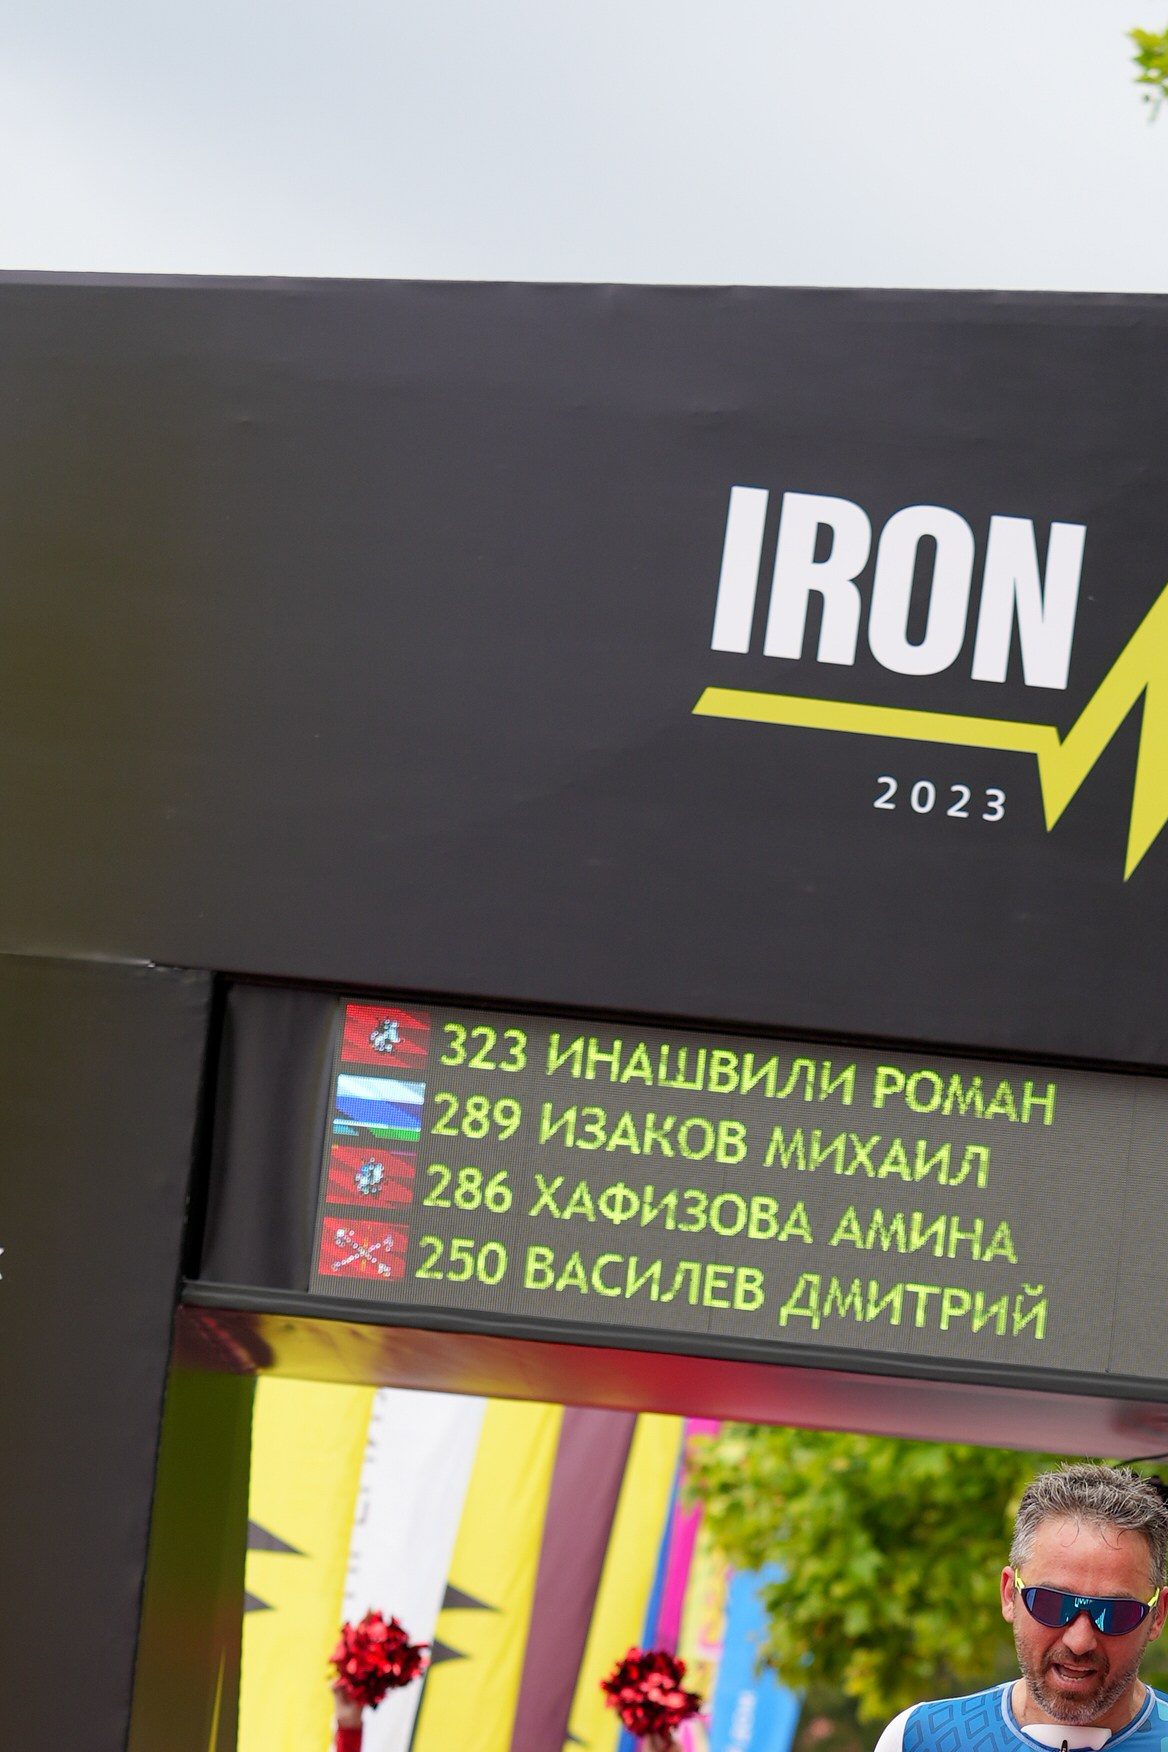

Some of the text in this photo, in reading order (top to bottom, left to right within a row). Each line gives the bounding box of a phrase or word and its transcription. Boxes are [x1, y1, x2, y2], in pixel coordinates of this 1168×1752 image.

[711, 486, 1086, 689] IRON
[873, 776, 1007, 822] 2023
[440, 1022, 1056, 1125] 323 ИНАШВИЛИ РОМАН
[431, 1091, 990, 1189] 289 ИЗАКОВ МИХАИЛ
[422, 1162, 1018, 1264] 286 ХАФИЗОВА АМИНА
[415, 1235, 1049, 1340] 250 ВАСИЛЕВ ДМИТРИЙ
